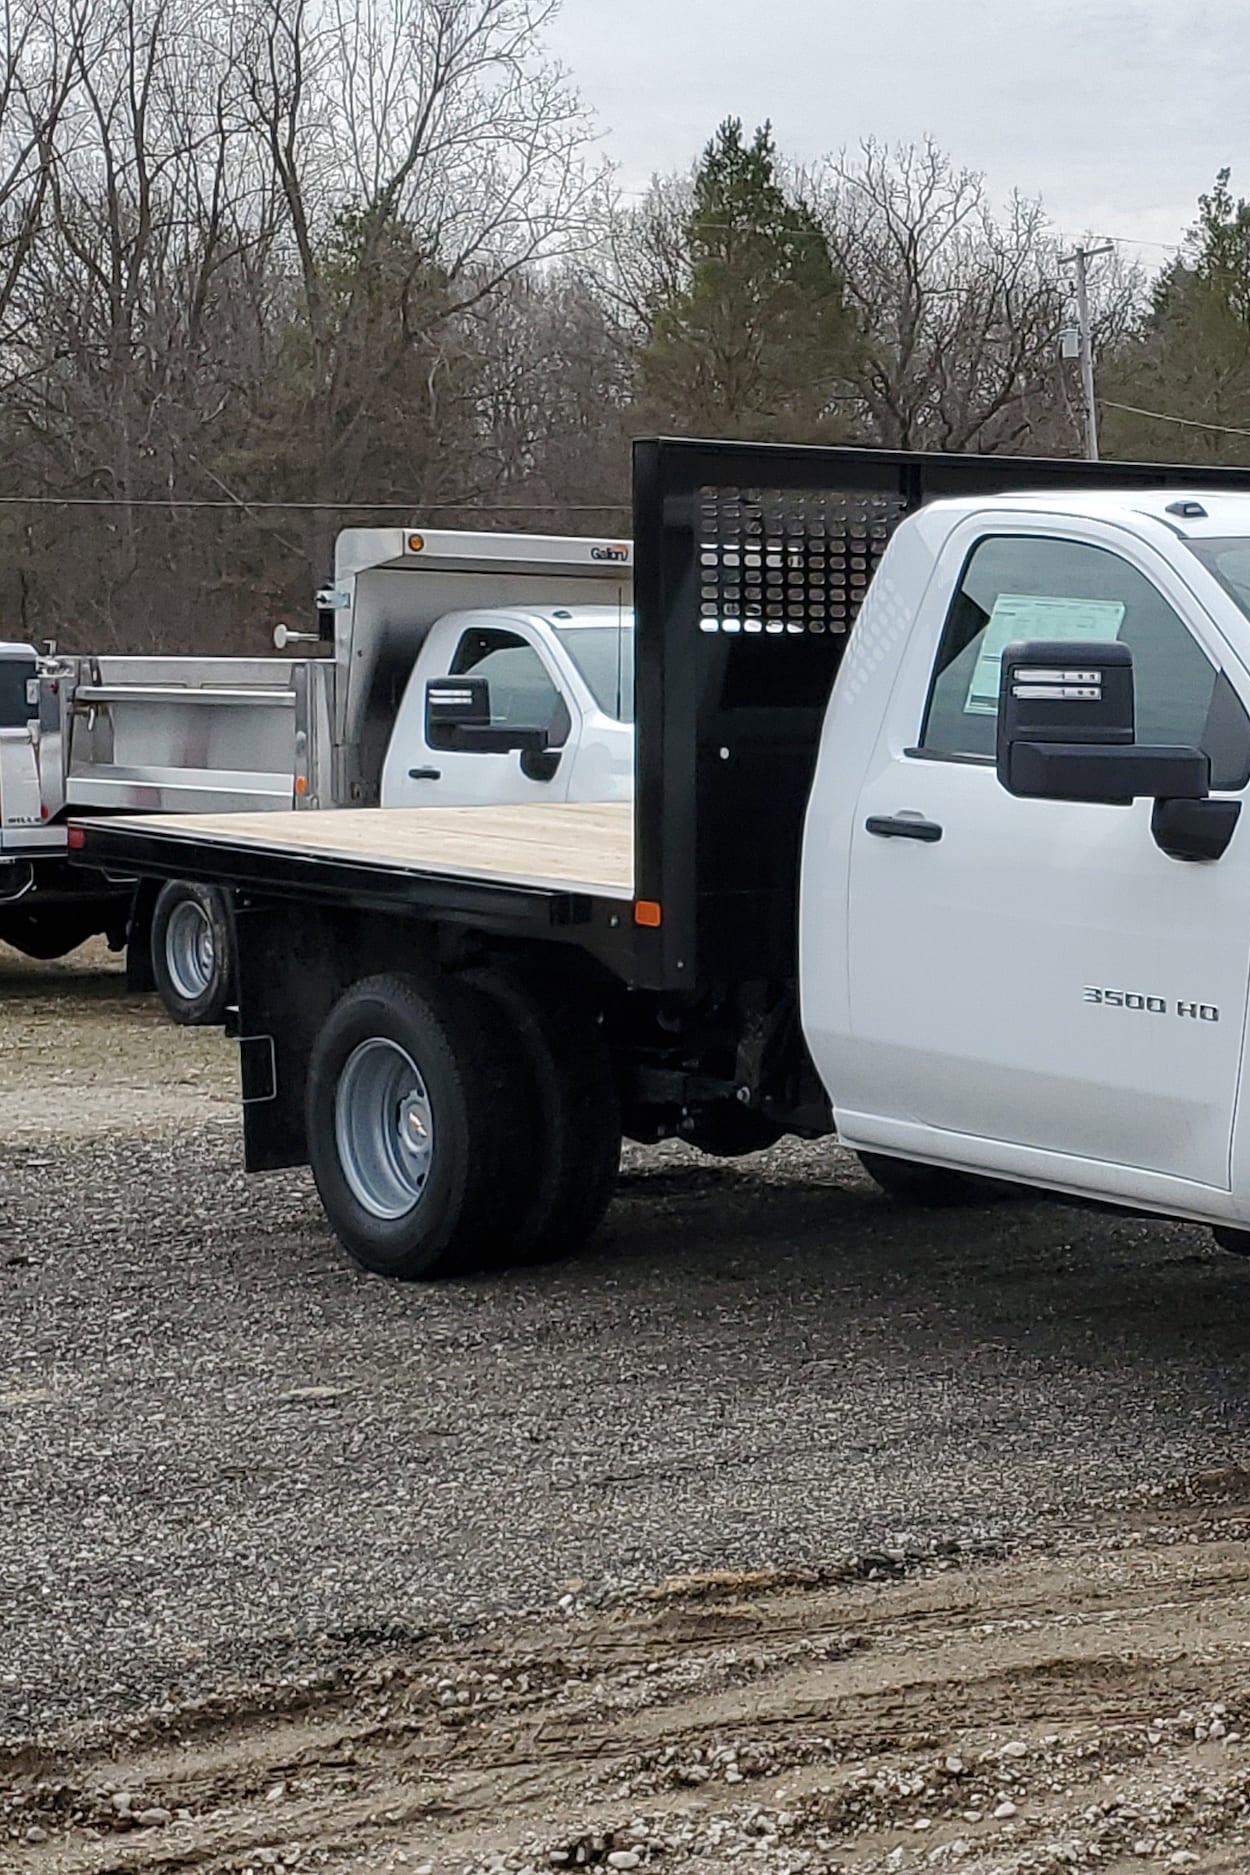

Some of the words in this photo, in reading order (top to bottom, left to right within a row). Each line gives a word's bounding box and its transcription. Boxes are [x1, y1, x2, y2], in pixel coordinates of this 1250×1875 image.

[590, 544, 629, 562] Galion
[1083, 985, 1167, 1014] 3500
[1176, 1000, 1220, 1022] HD
